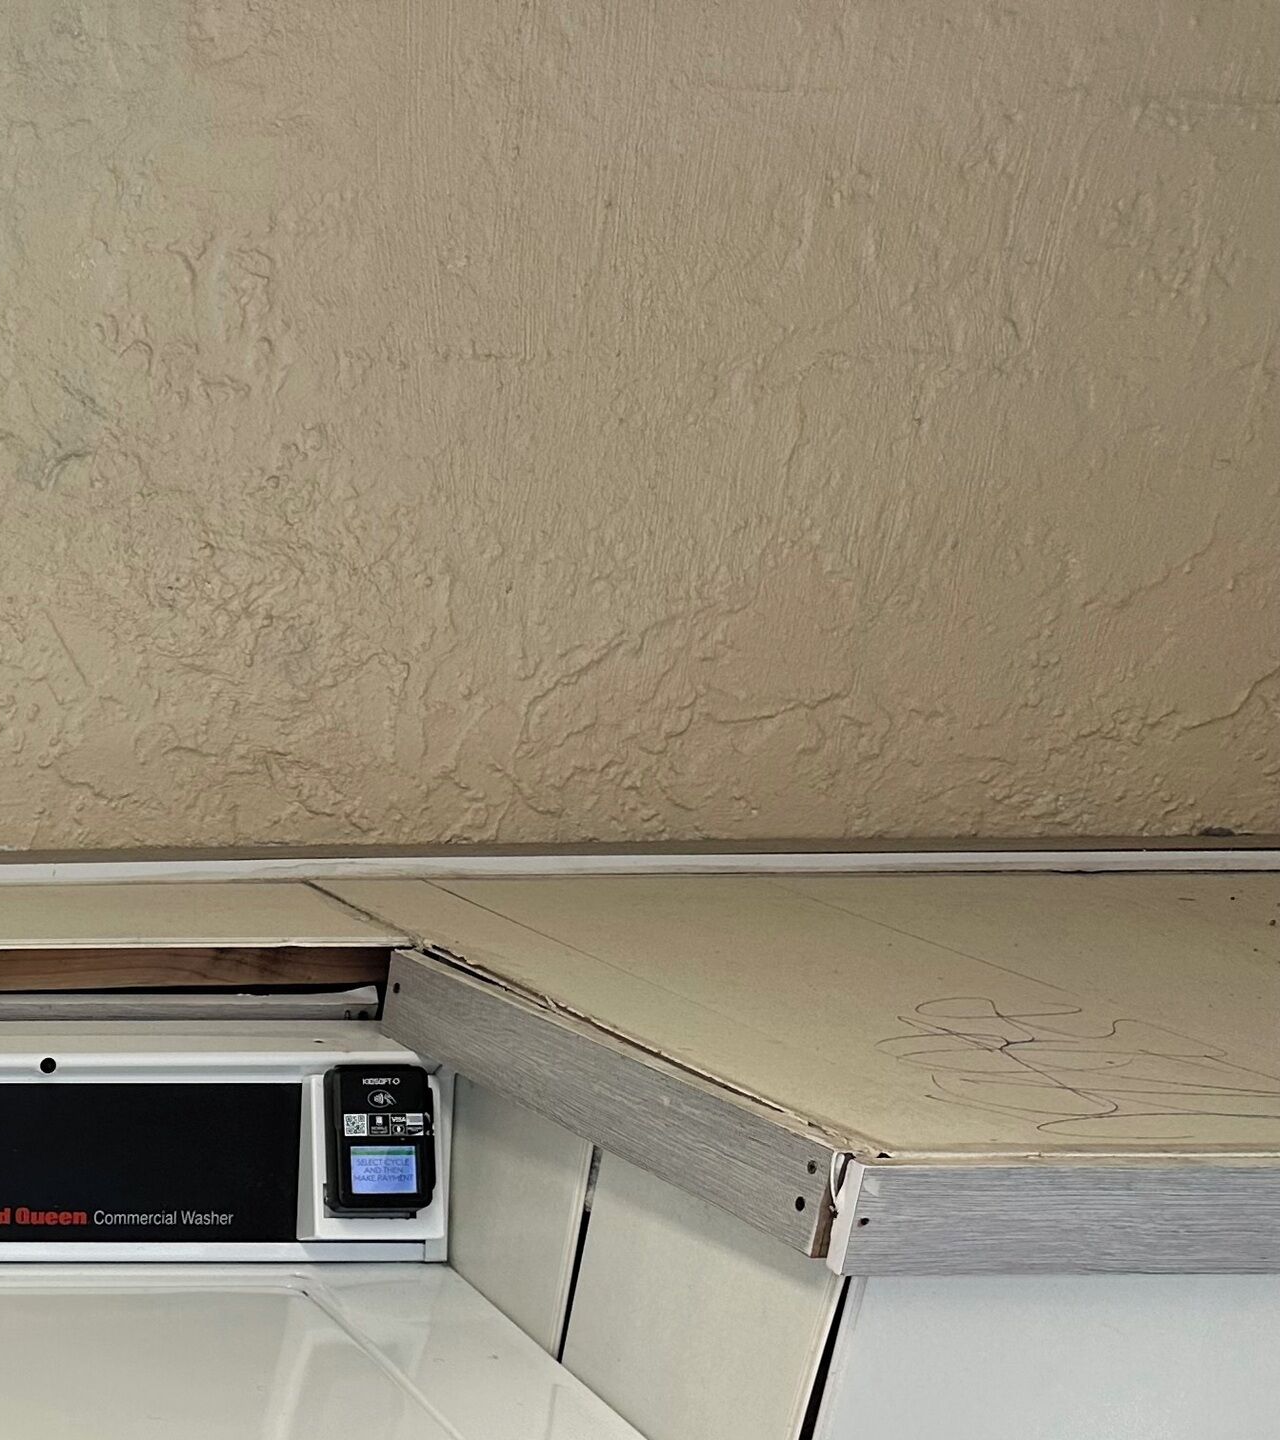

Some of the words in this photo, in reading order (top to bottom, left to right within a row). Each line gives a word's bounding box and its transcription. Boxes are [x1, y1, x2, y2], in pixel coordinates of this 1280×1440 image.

[15, 1207, 88, 1225] Queen
[93, 1210, 177, 1225] Commercial
[181, 1210, 234, 1226] Washer
